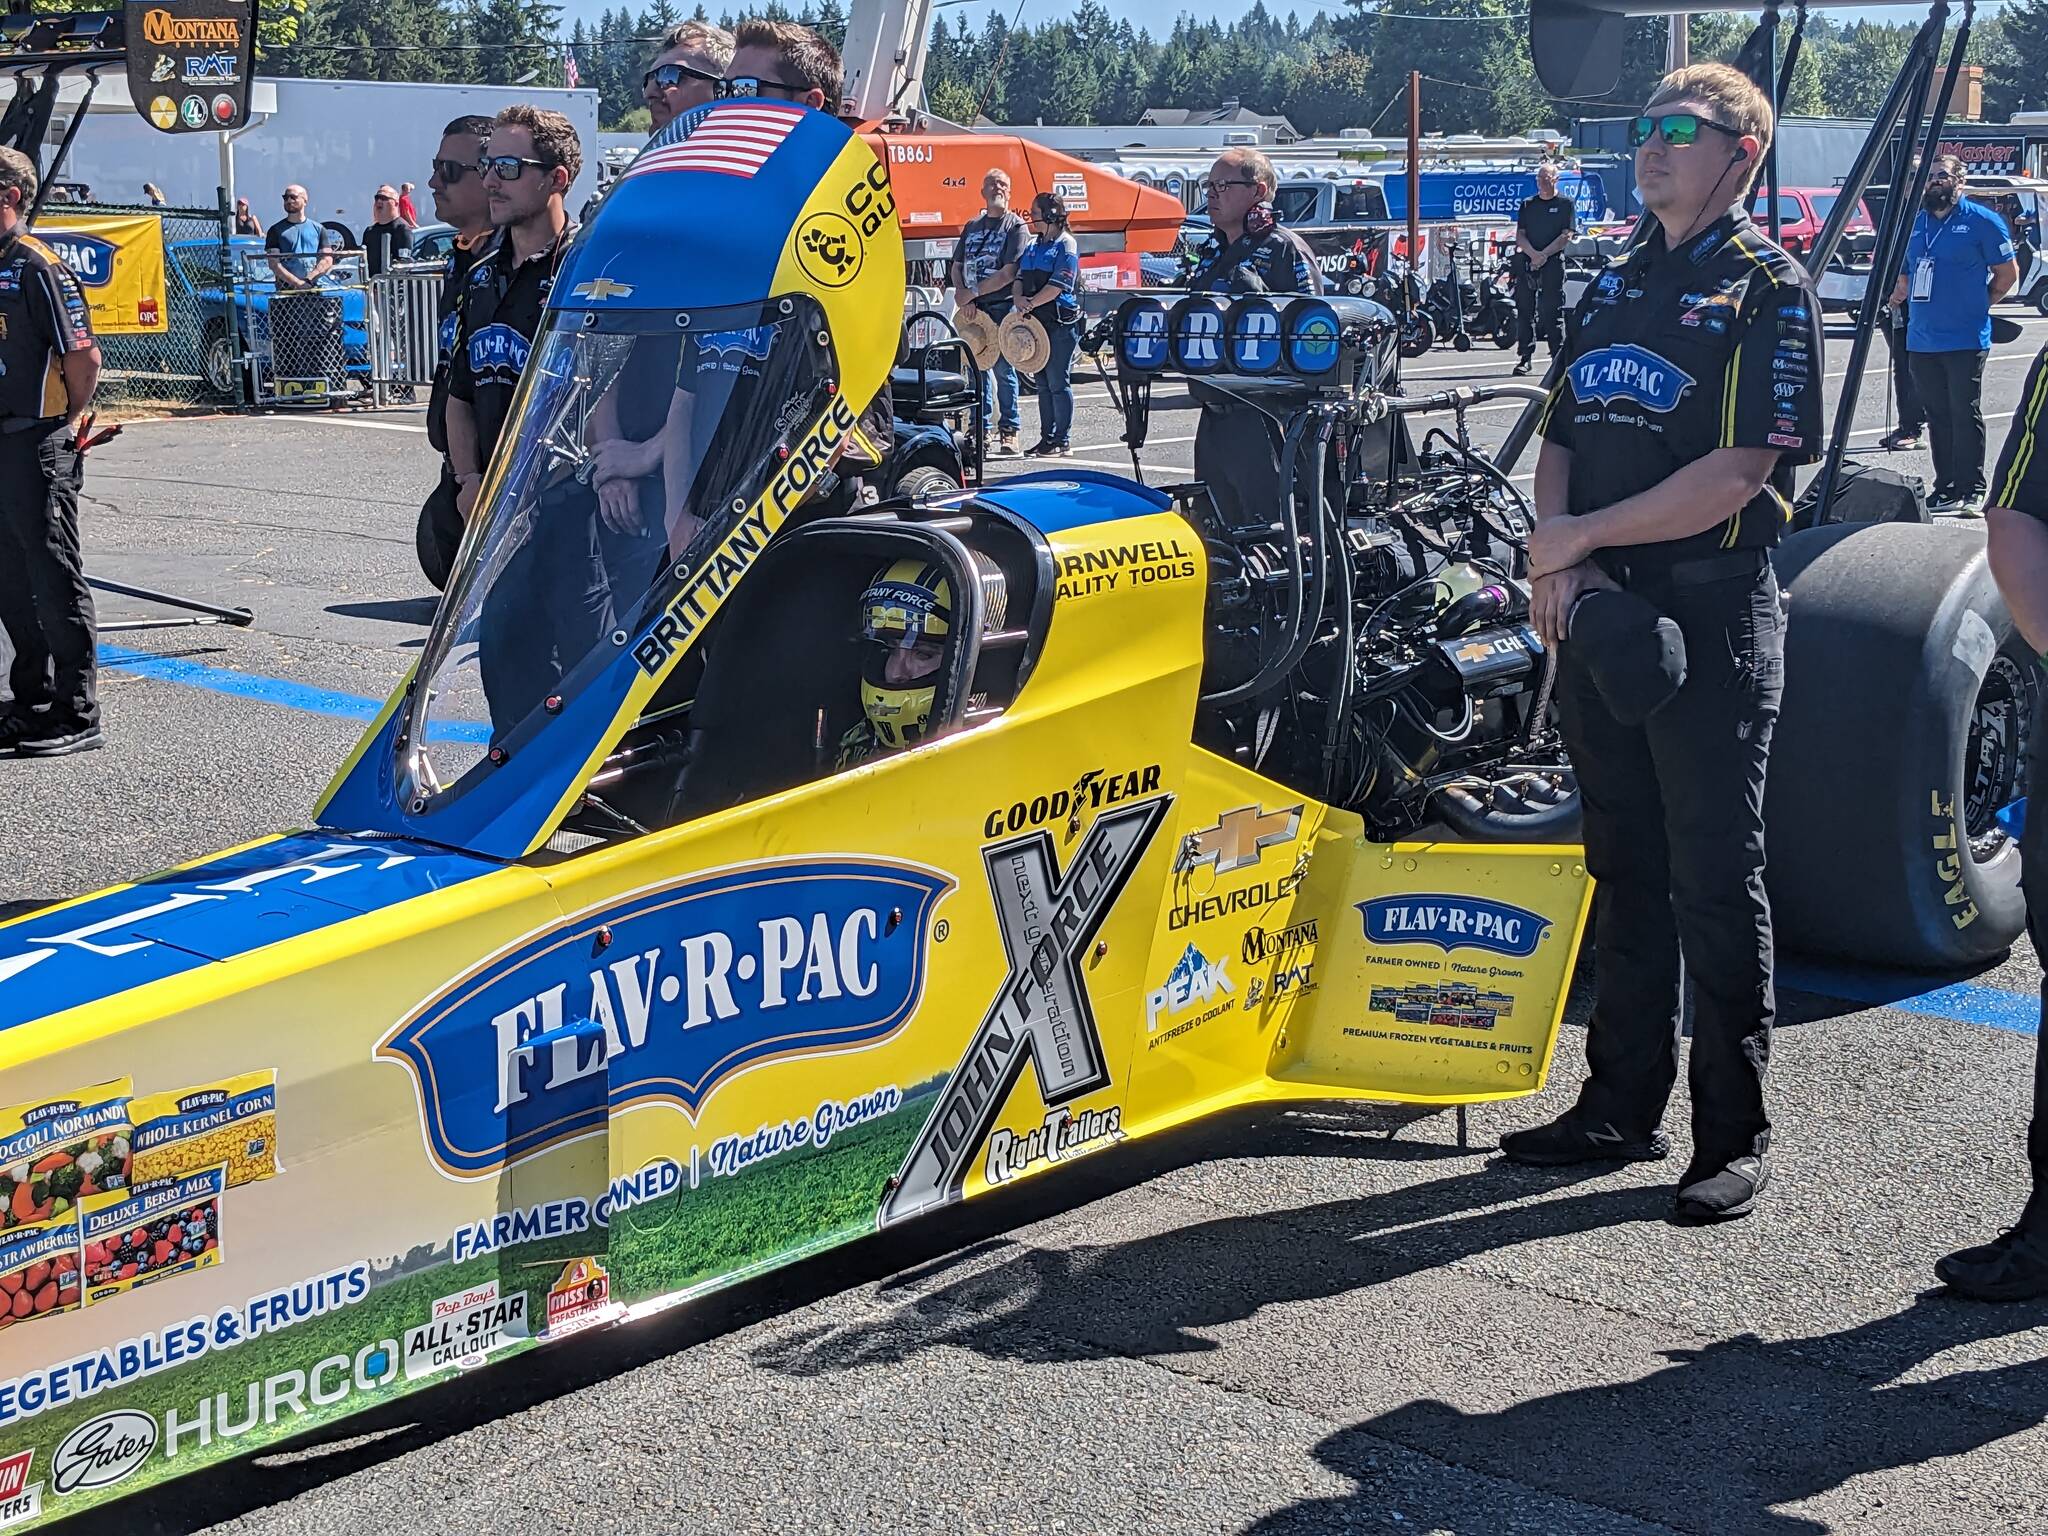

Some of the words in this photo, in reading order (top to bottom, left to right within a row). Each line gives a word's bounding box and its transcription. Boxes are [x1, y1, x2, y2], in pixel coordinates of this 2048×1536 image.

[144, 11, 240, 41] MONTANA
[184, 54, 237, 77] RMT
[889, 145, 933, 163] TB86J
[942, 177, 966, 187] 4x4
[1454, 183, 1524, 199] COMCAST
[631, 505, 773, 678] BRITTANY
[772, 396, 856, 516] FORCE
[1130, 560, 1196, 588] TOOLS
[892, 590, 936, 613] FORCE
[1243, 922, 1318, 964] MONTANA
[1274, 963, 1314, 995] RMT
[1365, 955, 1403, 967] FARMER
[1405, 958, 1441, 969] OWNED
[1450, 962, 1487, 974] Nature
[1488, 965, 1525, 978] Grown
[932, 1012, 1017, 1187] JOHN
[1013, 828, 1118, 1022] FORCE
[1145, 955, 1237, 1033] PEAK
[1148, 1016, 1194, 1051] ANTIFREEZE
[1202, 998, 1236, 1023] COOLANT
[1342, 1027, 1388, 1040] PREMIUM
[1389, 1032, 1427, 1043] FROZEN
[1429, 1035, 1488, 1051] VEGETABLES
[1489, 1042, 1497, 1051] &
[1498, 1043, 1534, 1054] FRUITS
[53, 1104, 128, 1138] NORMANDY
[137, 1123, 181, 1149] WHOLE
[183, 1107, 234, 1135] KERNEL
[235, 1094, 273, 1116] CORN
[454, 1198, 585, 1260] FARMER
[710, 1124, 811, 1177] Nature
[813, 1086, 901, 1147] Grown
[89, 1201, 140, 1231] DELUXE
[144, 1184, 183, 1210] BERRY
[185, 1175, 212, 1194] MIX
[216, 1312, 240, 1345] &
[249, 1266, 366, 1335] FRUITS
[435, 1300, 462, 1316] Pep
[463, 1285, 497, 1308] Boys
[408, 1326, 453, 1357] ALL
[466, 1296, 525, 1338] STAR
[432, 1331, 499, 1367] CALLOUT
[166, 1339, 400, 1458] HURCO
[62, 1422, 150, 1485] Gates
